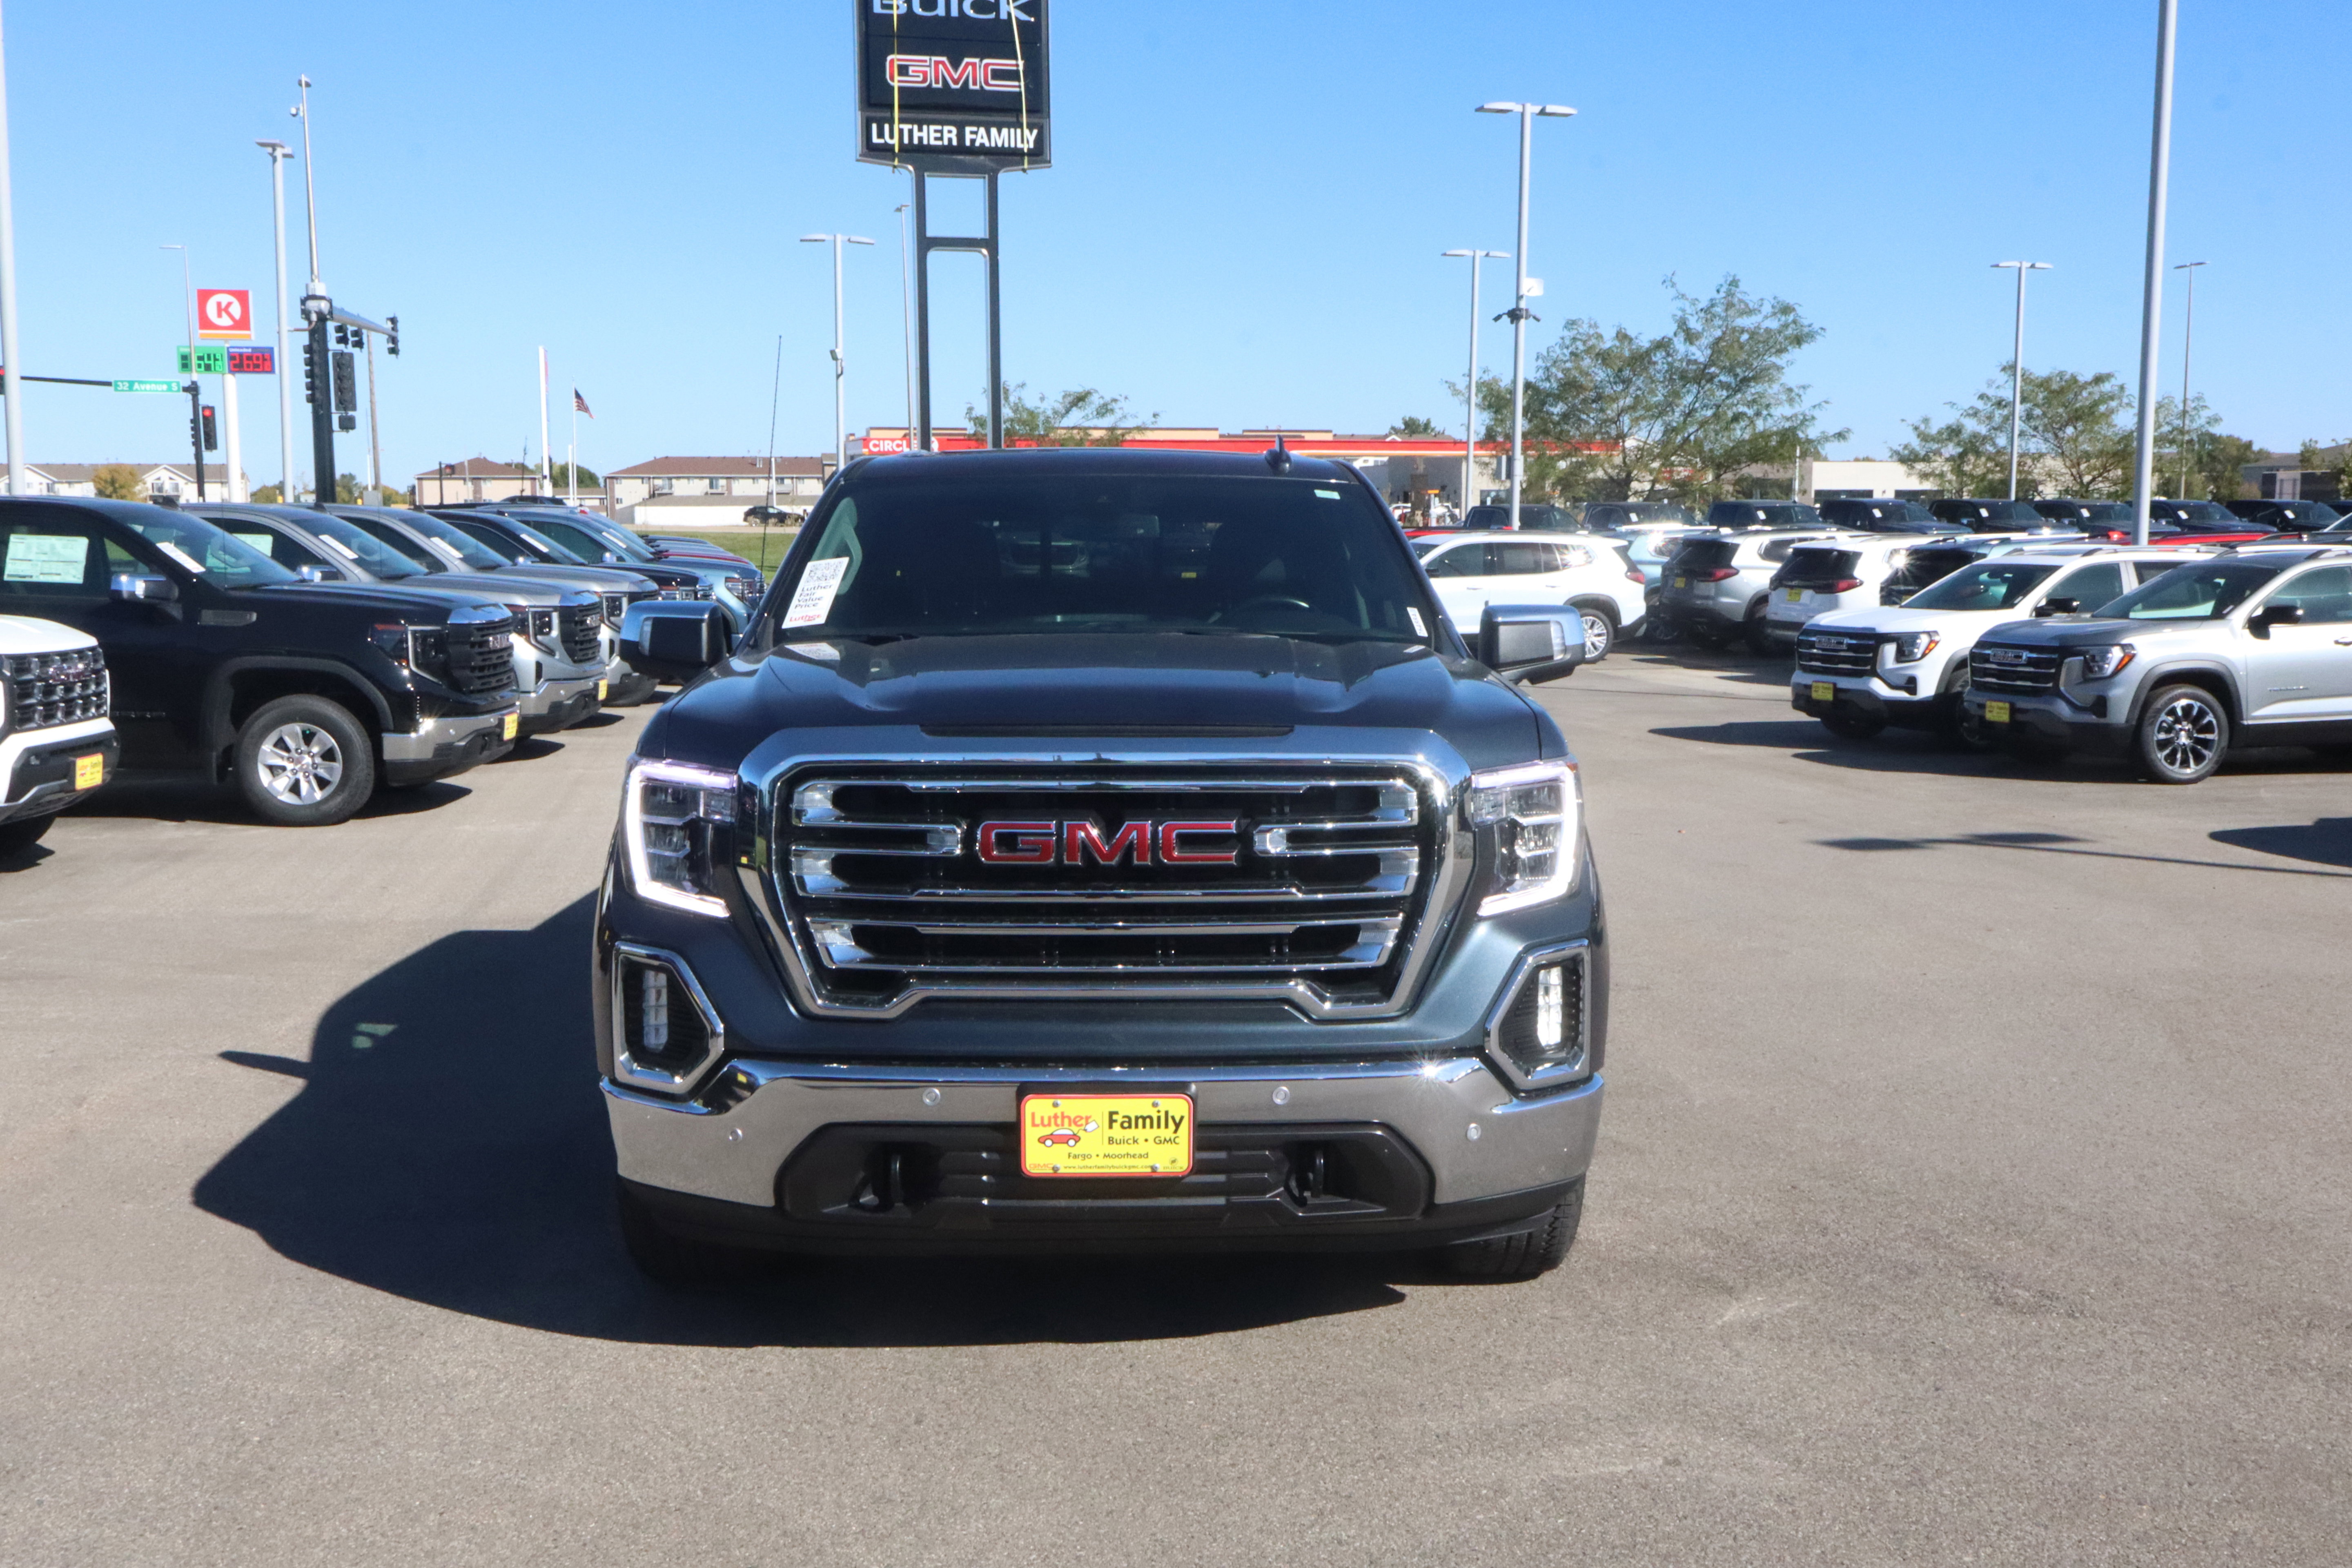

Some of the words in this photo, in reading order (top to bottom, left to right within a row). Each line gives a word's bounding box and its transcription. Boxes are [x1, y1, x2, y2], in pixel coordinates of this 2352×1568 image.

[886, 54, 1024, 91] GMC
[871, 123, 957, 146] LUTHER
[965, 127, 1038, 149] FAMILY
[117, 382, 129, 390] 32
[133, 382, 168, 391] Avenue
[171, 382, 178, 391] S
[976, 820, 1237, 865] GMC
[1031, 1111, 1092, 1127] Luther
[1108, 1109, 1185, 1134] Family
[1108, 1136, 1139, 1145] Buick
[1154, 1136, 1180, 1145] GMC
[1068, 1152, 1092, 1161] Fargo
